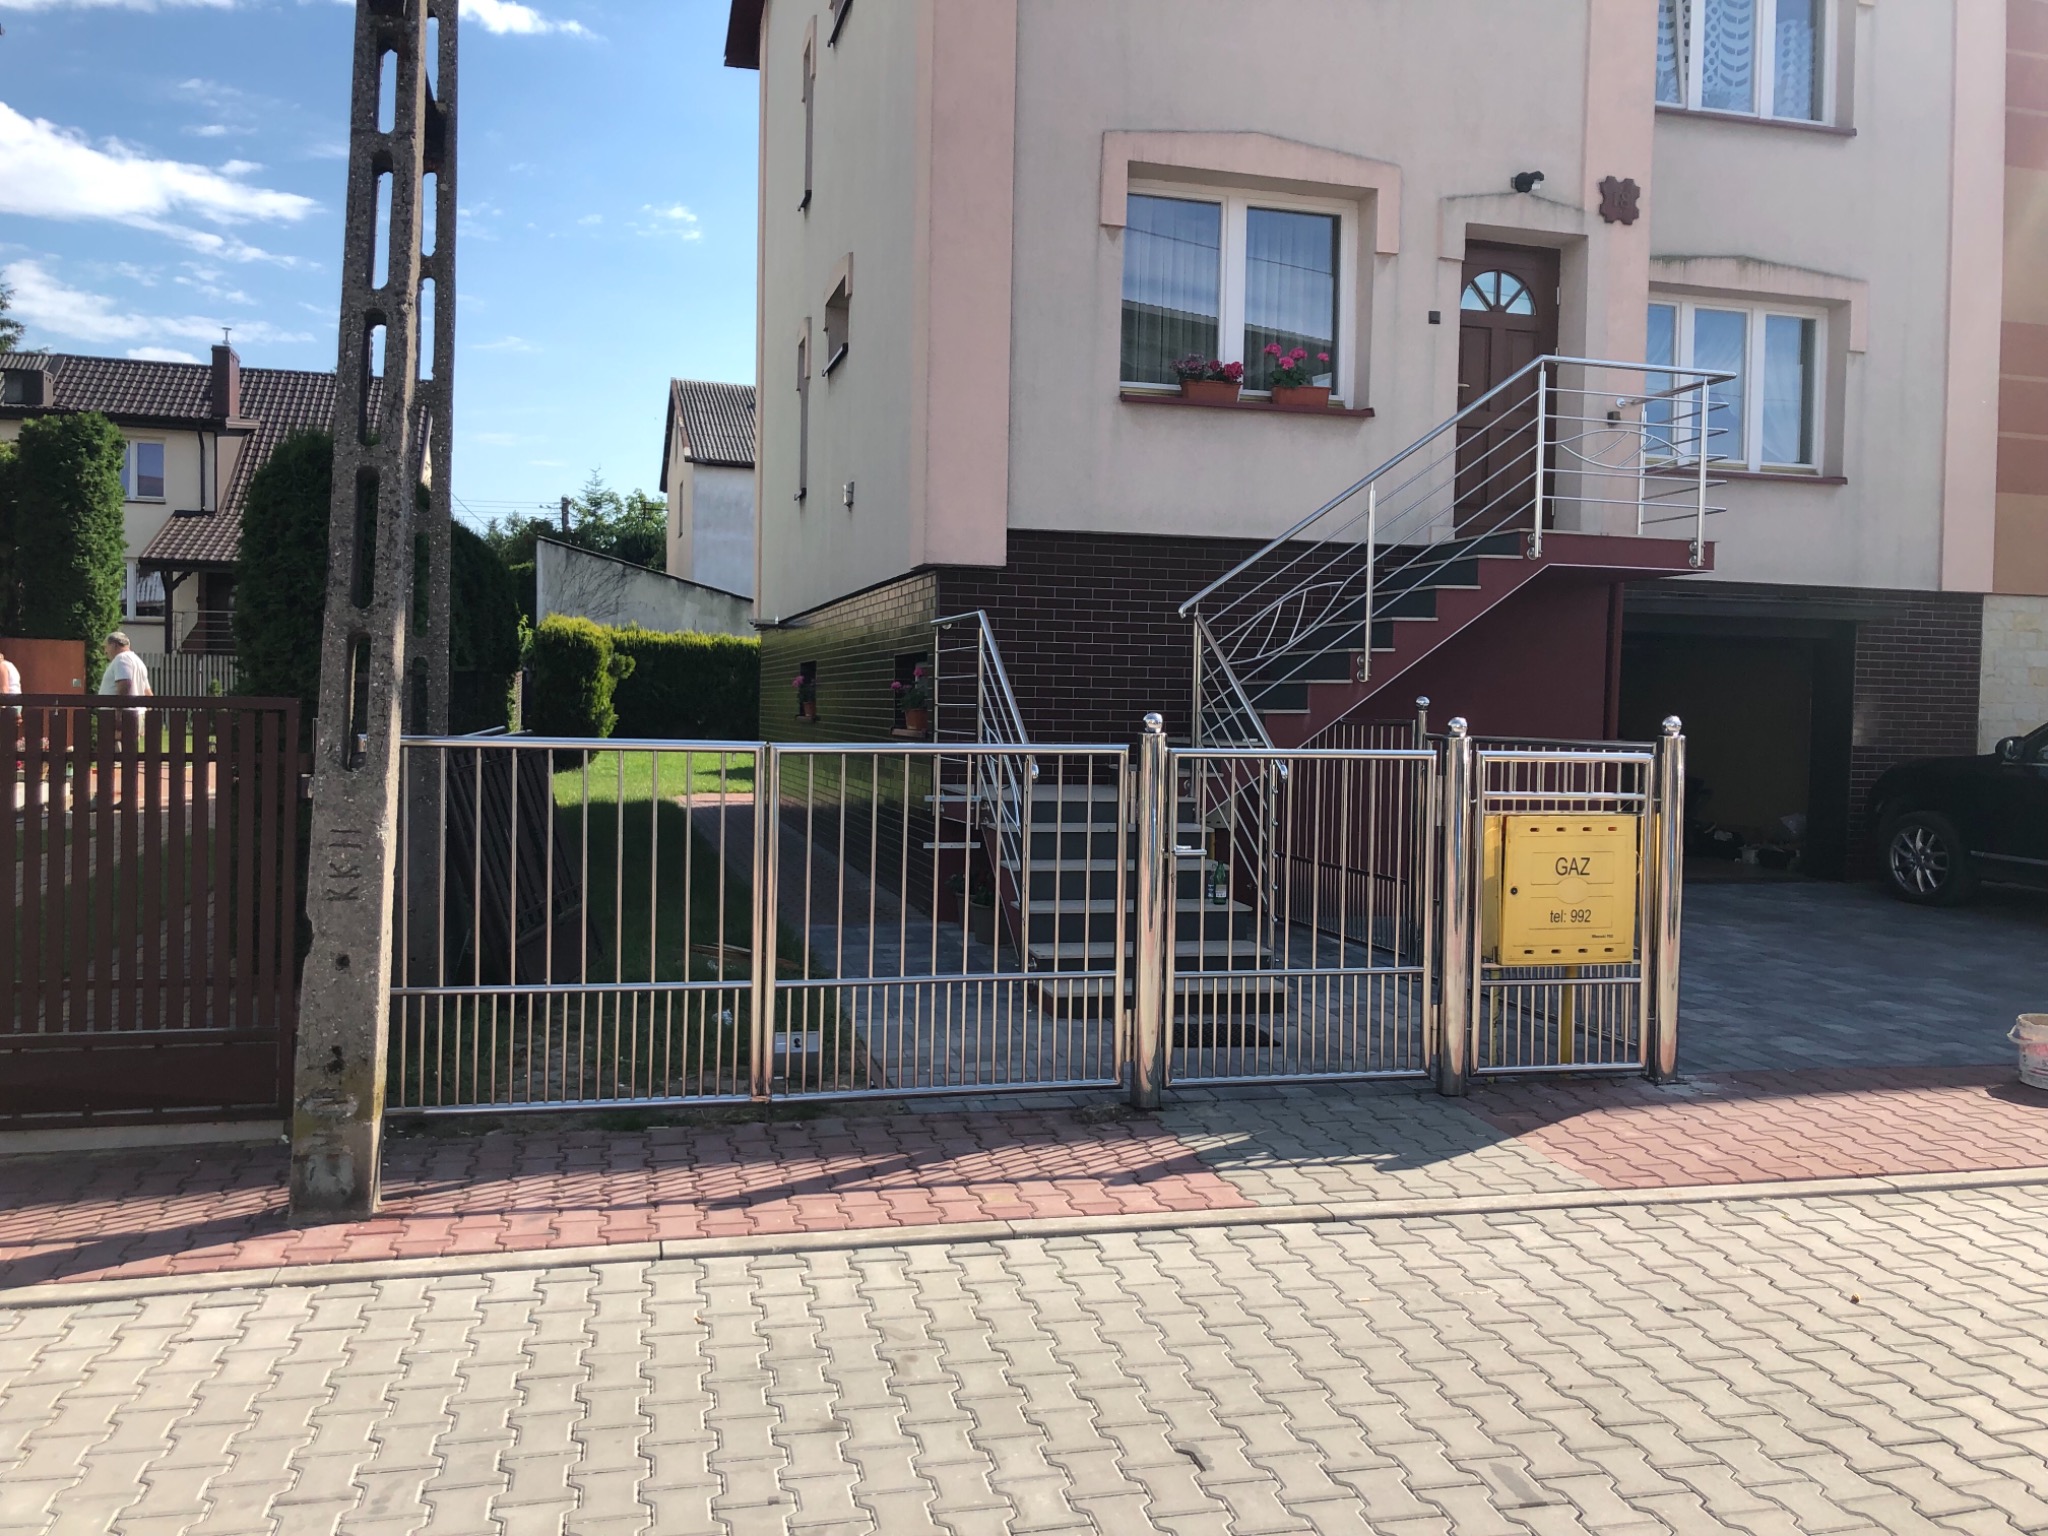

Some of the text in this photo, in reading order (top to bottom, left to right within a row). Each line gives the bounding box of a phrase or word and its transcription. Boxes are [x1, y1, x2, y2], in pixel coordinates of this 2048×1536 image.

[1555, 857, 1591, 876] GAZ
[1549, 909, 1592, 923] tel: 992
